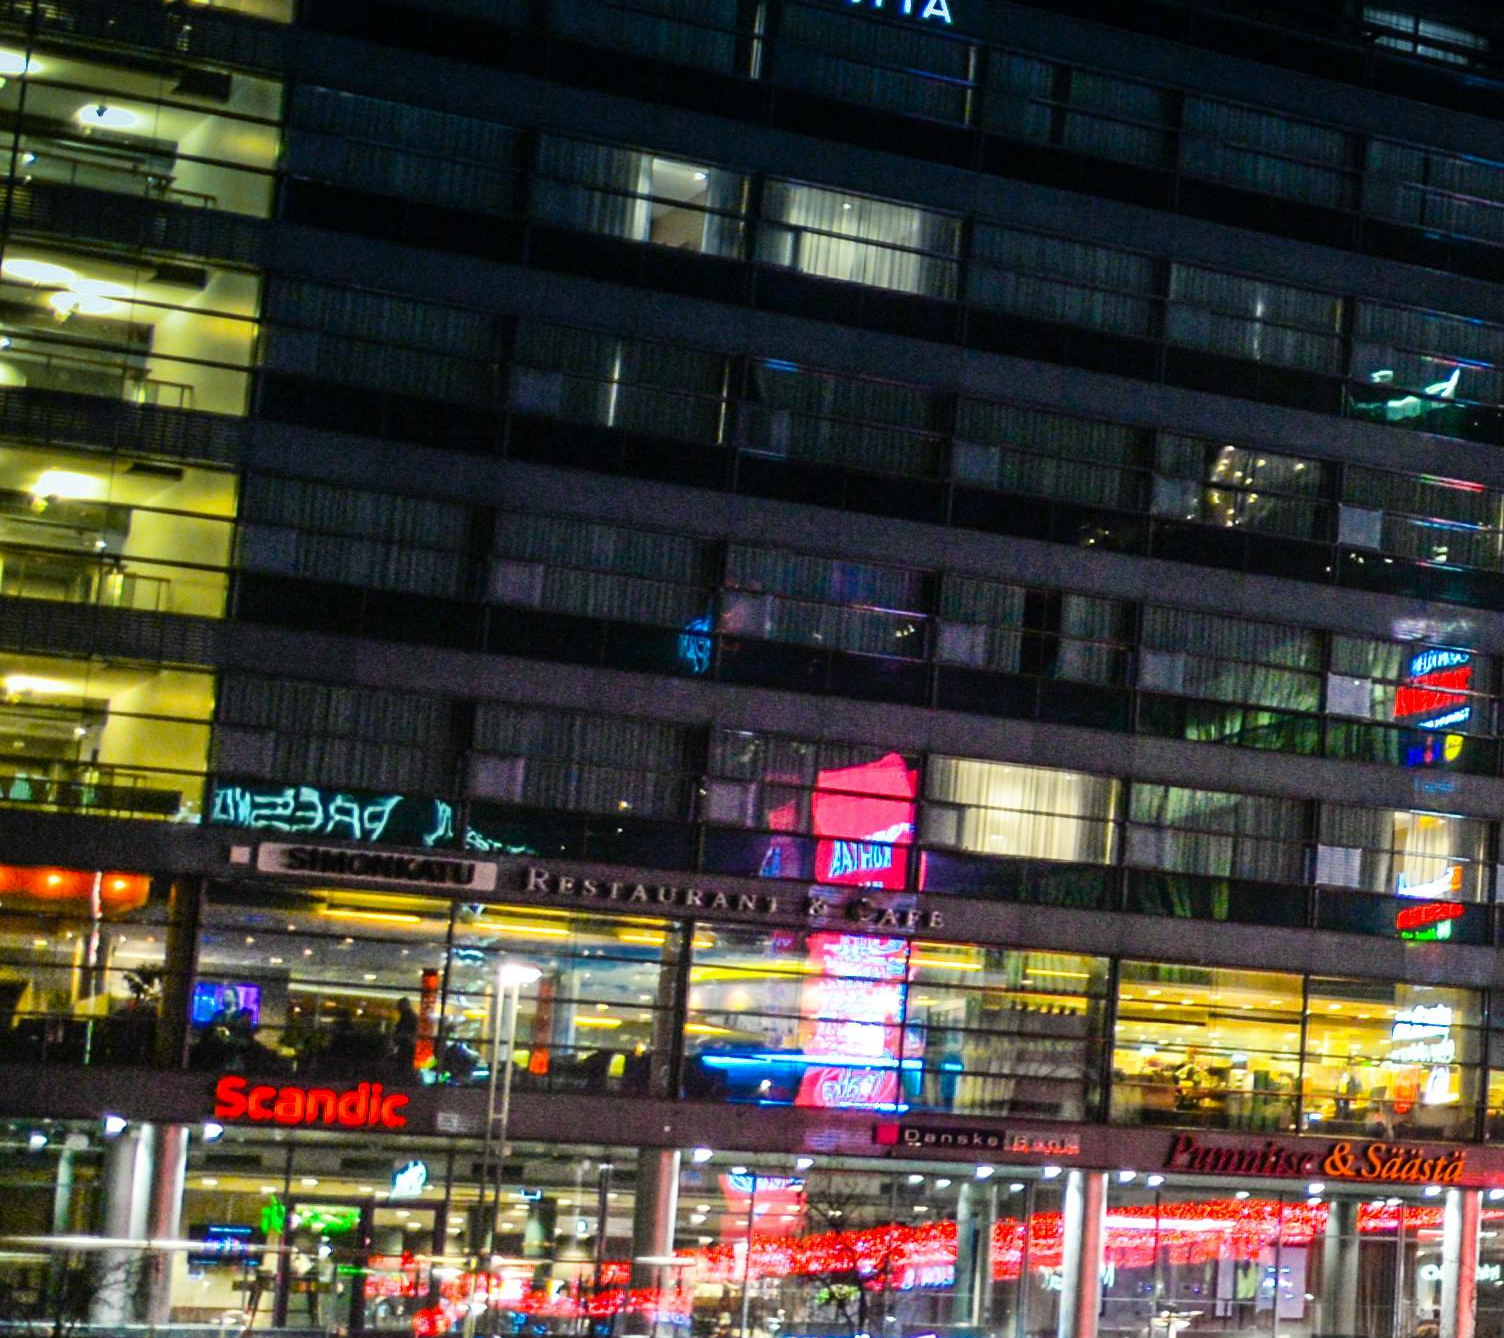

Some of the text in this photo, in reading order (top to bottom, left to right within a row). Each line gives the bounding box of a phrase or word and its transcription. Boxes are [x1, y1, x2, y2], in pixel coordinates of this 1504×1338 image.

[522, 866, 780, 915] RESTAURANT
[215, 1075, 410, 1129] Scandic
[903, 1128, 999, 1149] Danske
[1323, 1142, 1356, 1178] &
[1362, 1141, 1466, 1183] Säästä
